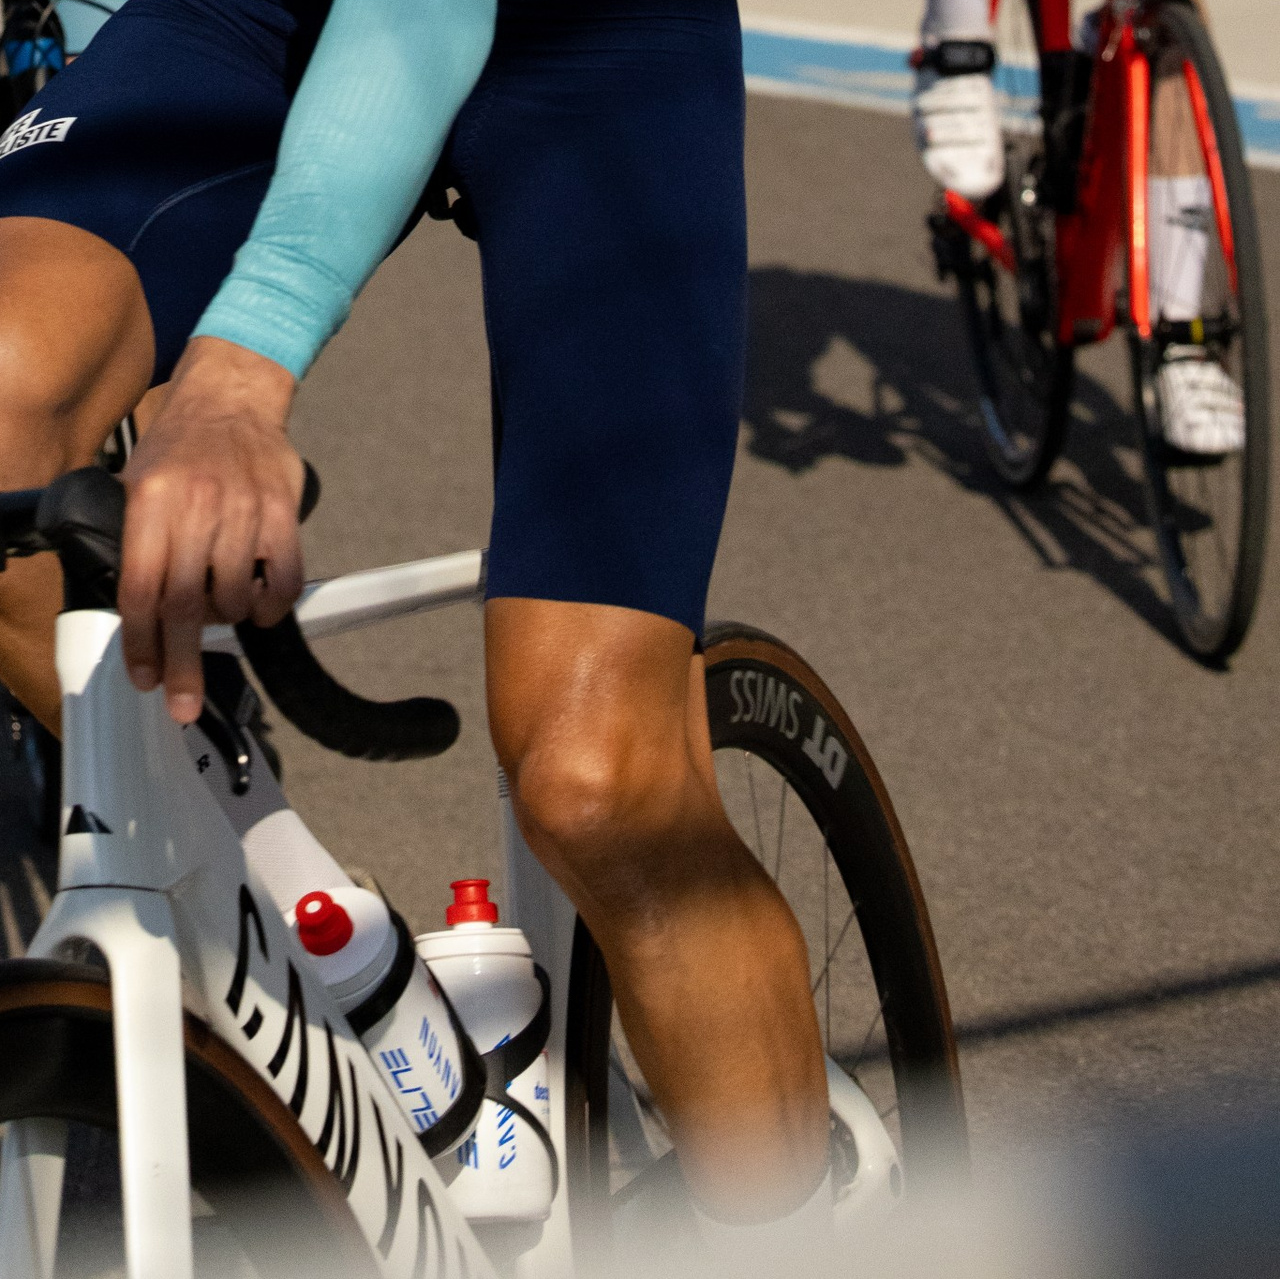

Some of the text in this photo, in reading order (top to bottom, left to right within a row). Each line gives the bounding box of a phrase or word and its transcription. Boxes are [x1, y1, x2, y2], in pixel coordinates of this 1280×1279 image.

[730, 670, 849, 791] DT SWISS
[379, 1046, 440, 1132] ELITE
